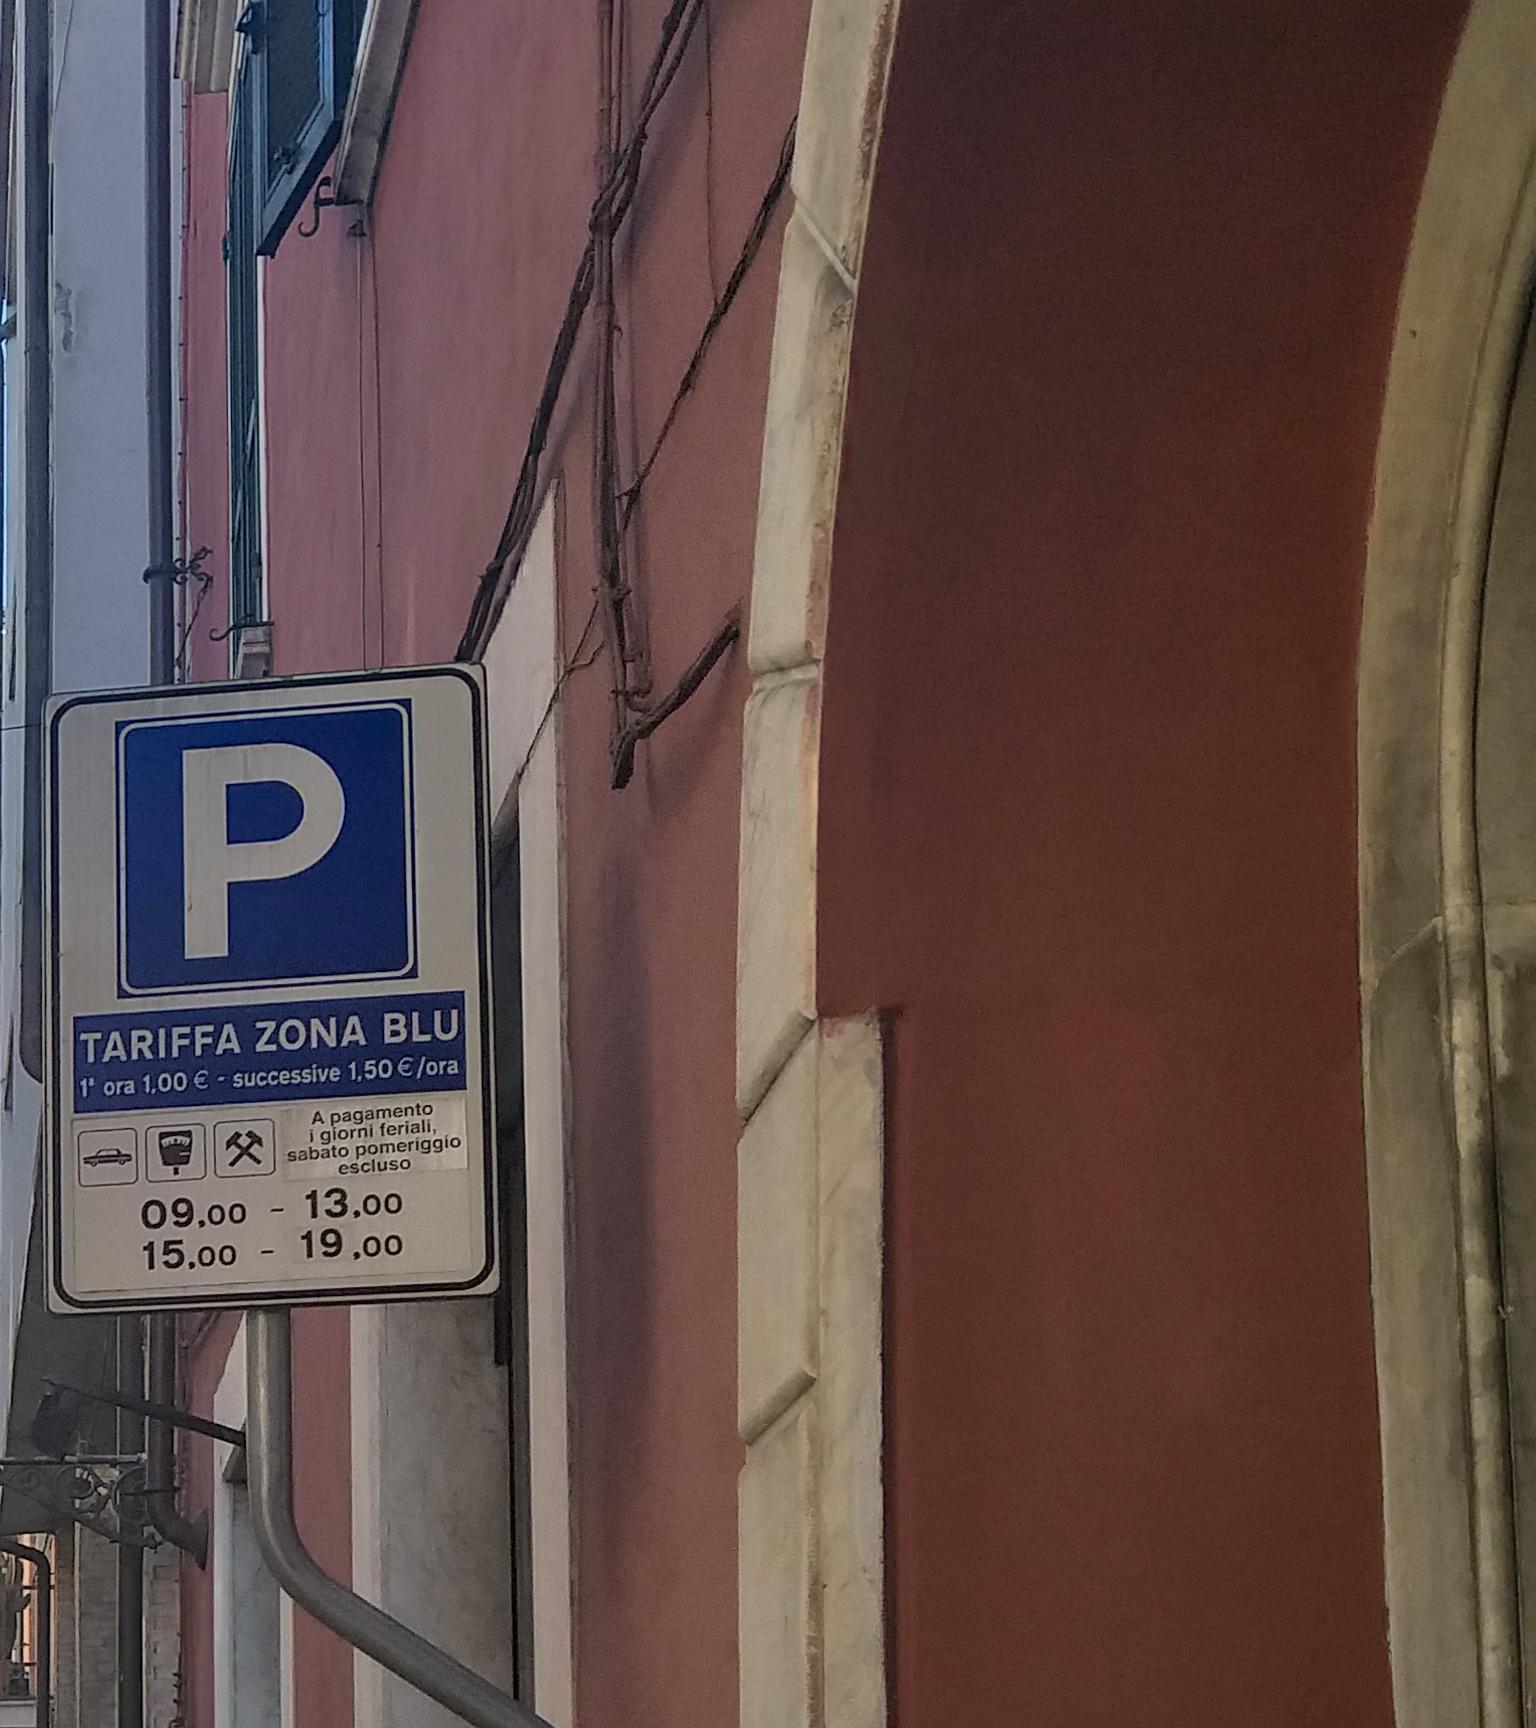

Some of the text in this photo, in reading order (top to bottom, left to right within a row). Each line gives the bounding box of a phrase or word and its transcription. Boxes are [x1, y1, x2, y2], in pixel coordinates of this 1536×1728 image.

[182, 743, 346, 959] P
[79, 1007, 460, 1064] TARIFFA ZONA BLU
[103, 1079, 136, 1096] ora
[142, 1071, 188, 1095] 1,00
[232, 1063, 341, 1089] successive
[311, 1103, 434, 1127] A pagamento
[287, 1135, 462, 1162] sabato pomeriggio
[320, 1124, 374, 1145] giorni
[338, 1158, 411, 1176] escluso
[140, 1197, 247, 1230] 09,00
[304, 1187, 403, 1219] 13,00
[142, 1239, 237, 1270] 15,00
